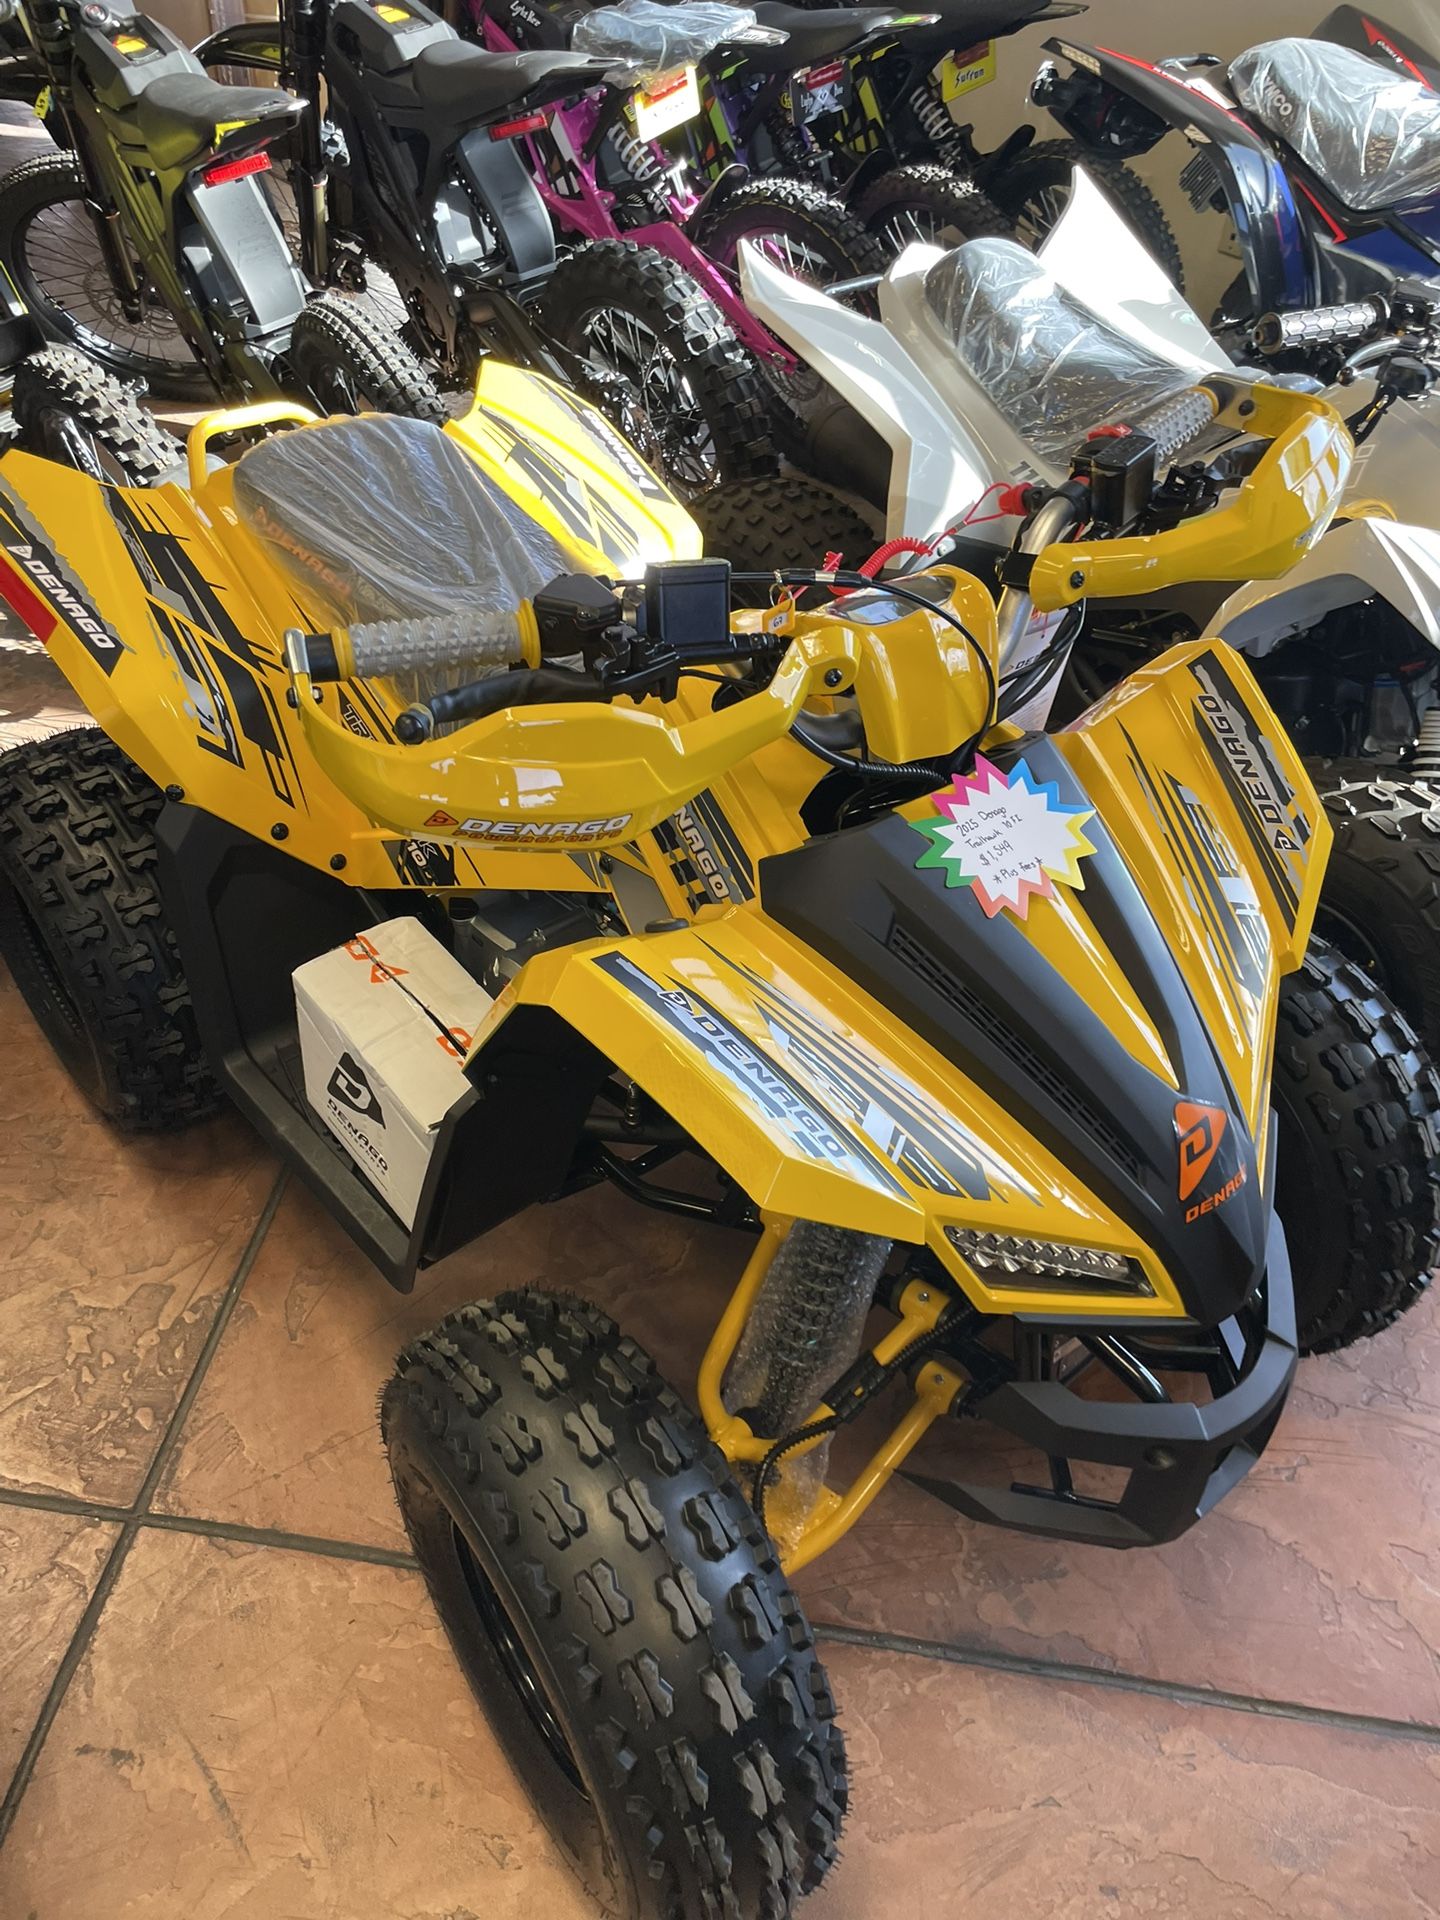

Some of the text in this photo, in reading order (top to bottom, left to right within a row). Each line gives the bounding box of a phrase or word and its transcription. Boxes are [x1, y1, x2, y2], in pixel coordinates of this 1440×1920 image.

[268, 521, 350, 597] DENAGO
[23, 560, 116, 648] DENAGO
[1197, 694, 1284, 824] DENAGO
[451, 828, 623, 844] POWERSPORTS
[458, 813, 634, 836] DENAGO
[956, 818, 980, 837] 2025
[964, 827, 1003, 849] Trailhawk
[407, 841, 428, 868] 10
[978, 840, 1015, 867] $1,549
[693, 1016, 848, 1159] DENAGO
[328, 1098, 389, 1172] DENAGO
